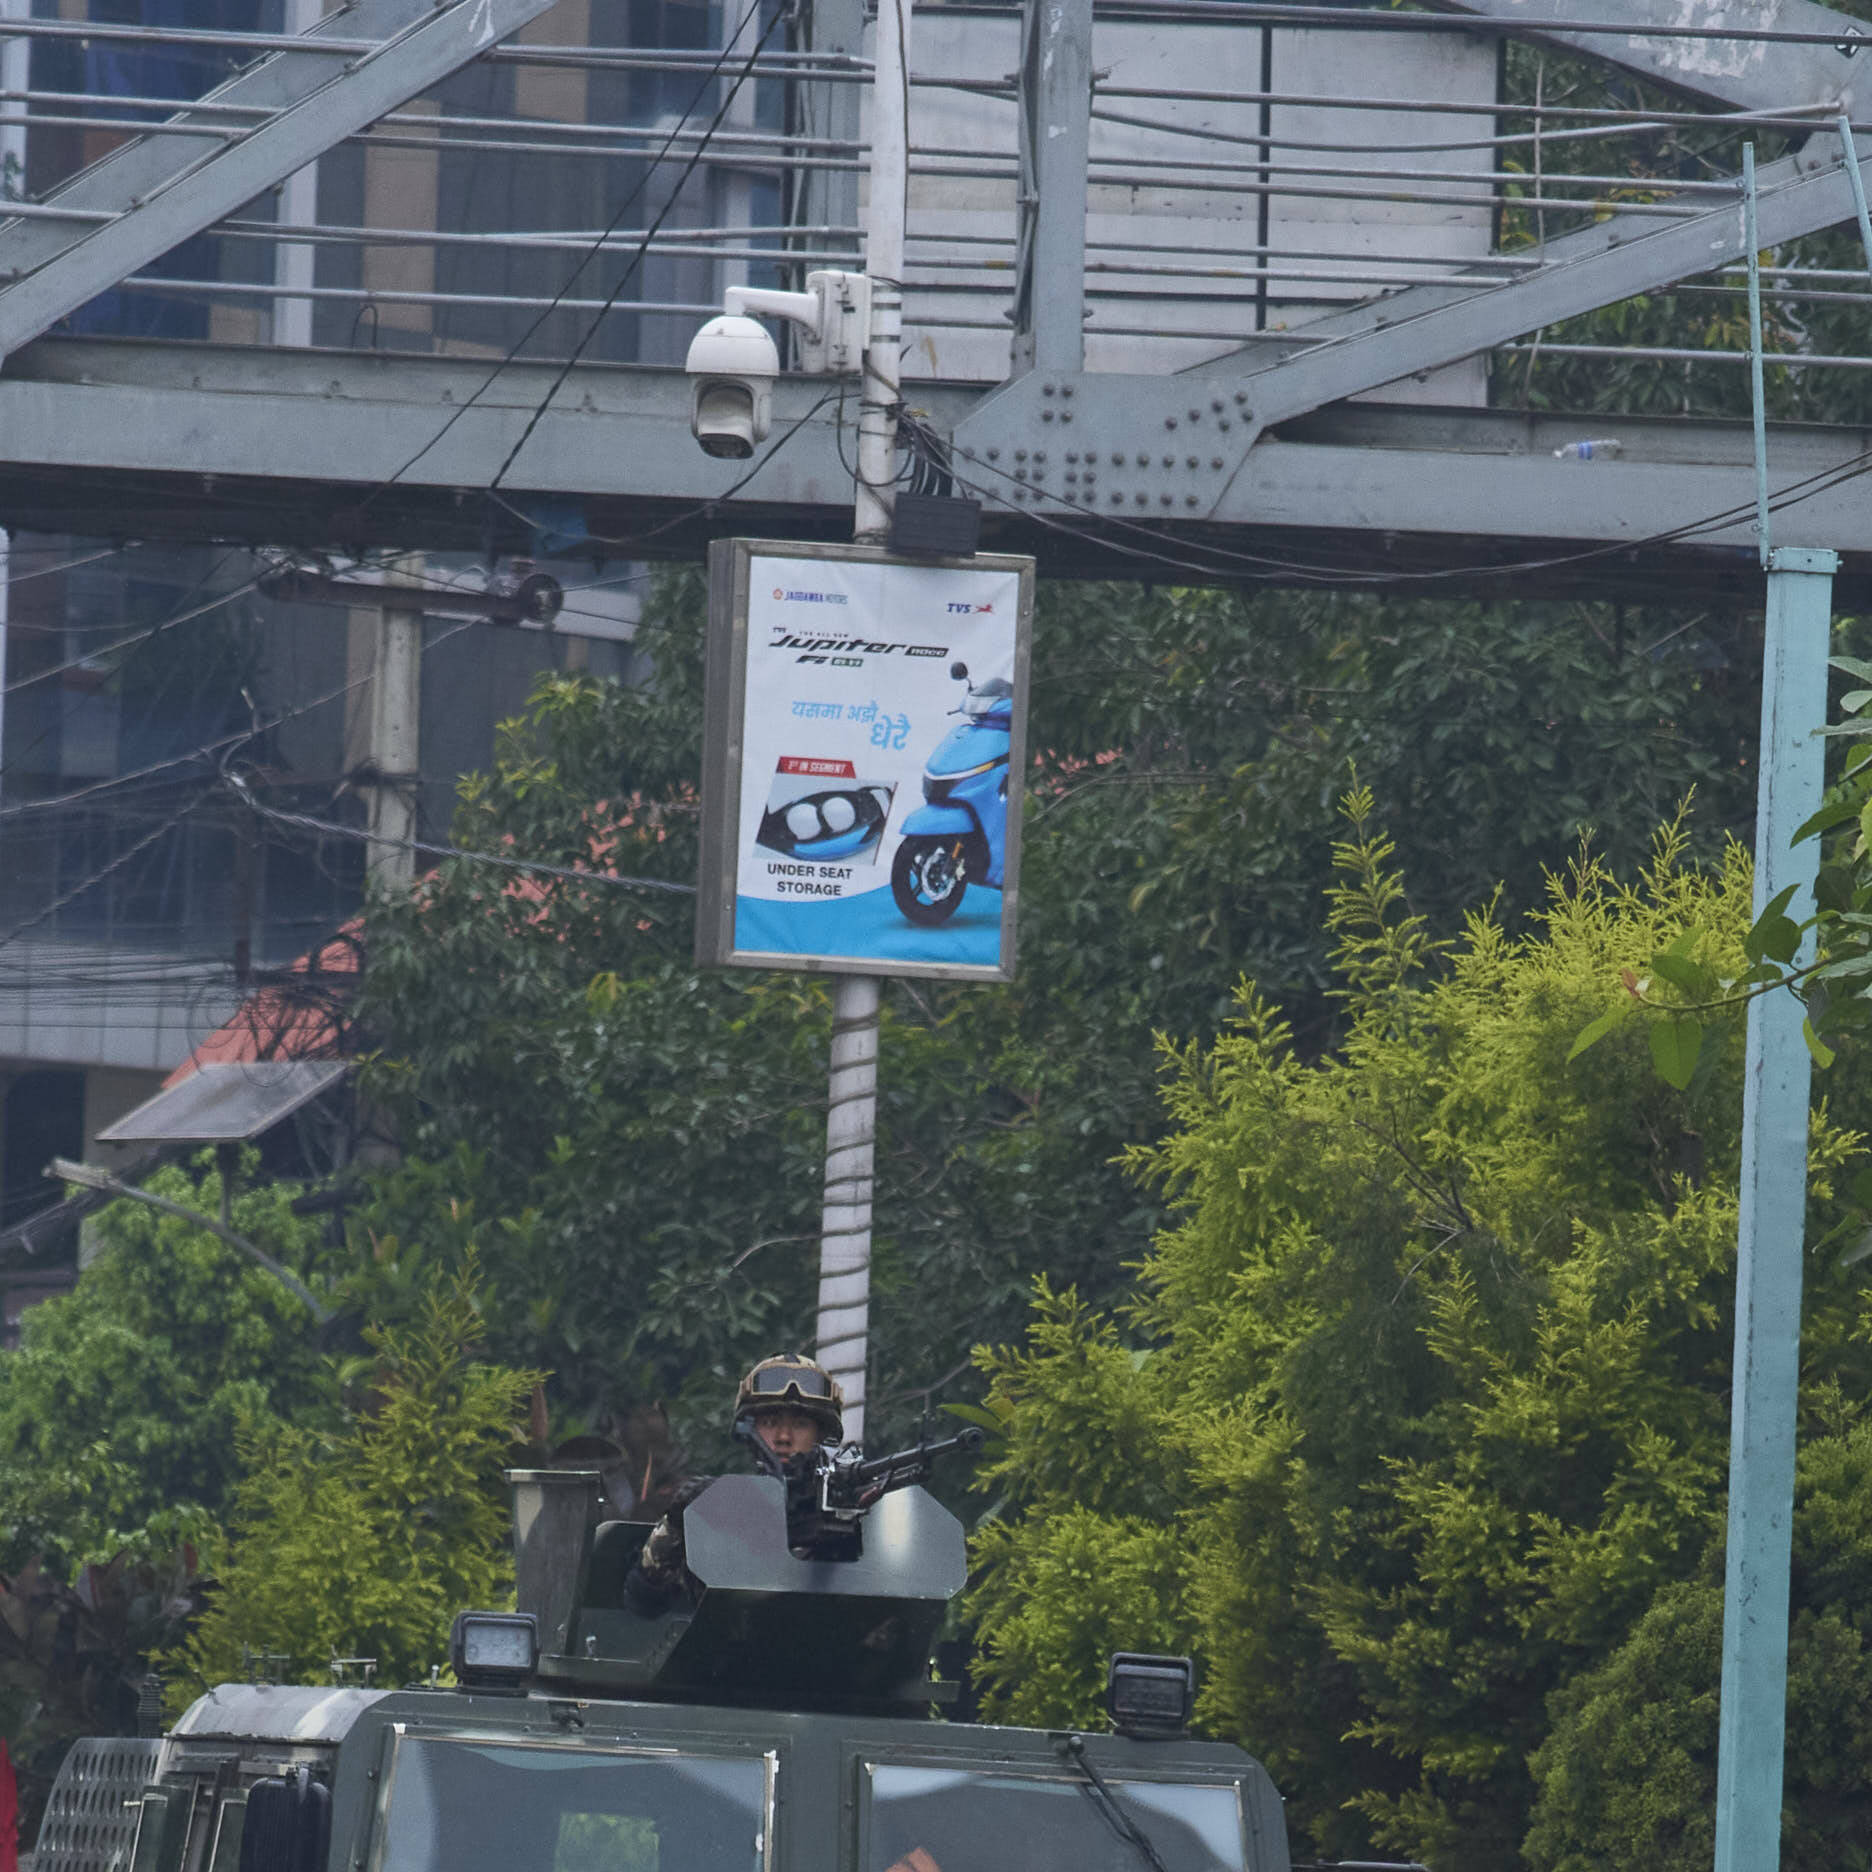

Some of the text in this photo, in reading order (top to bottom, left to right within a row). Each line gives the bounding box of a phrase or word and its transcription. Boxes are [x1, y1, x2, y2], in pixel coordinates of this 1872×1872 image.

[947, 603, 972, 614] TVS
[768, 634, 906, 653] Jupiter
[792, 701, 844, 720] यसमा
[870, 713, 911, 750] धेरै
[767, 863, 853, 880] UNDER SEAT
[777, 881, 842, 897] STORAGE
